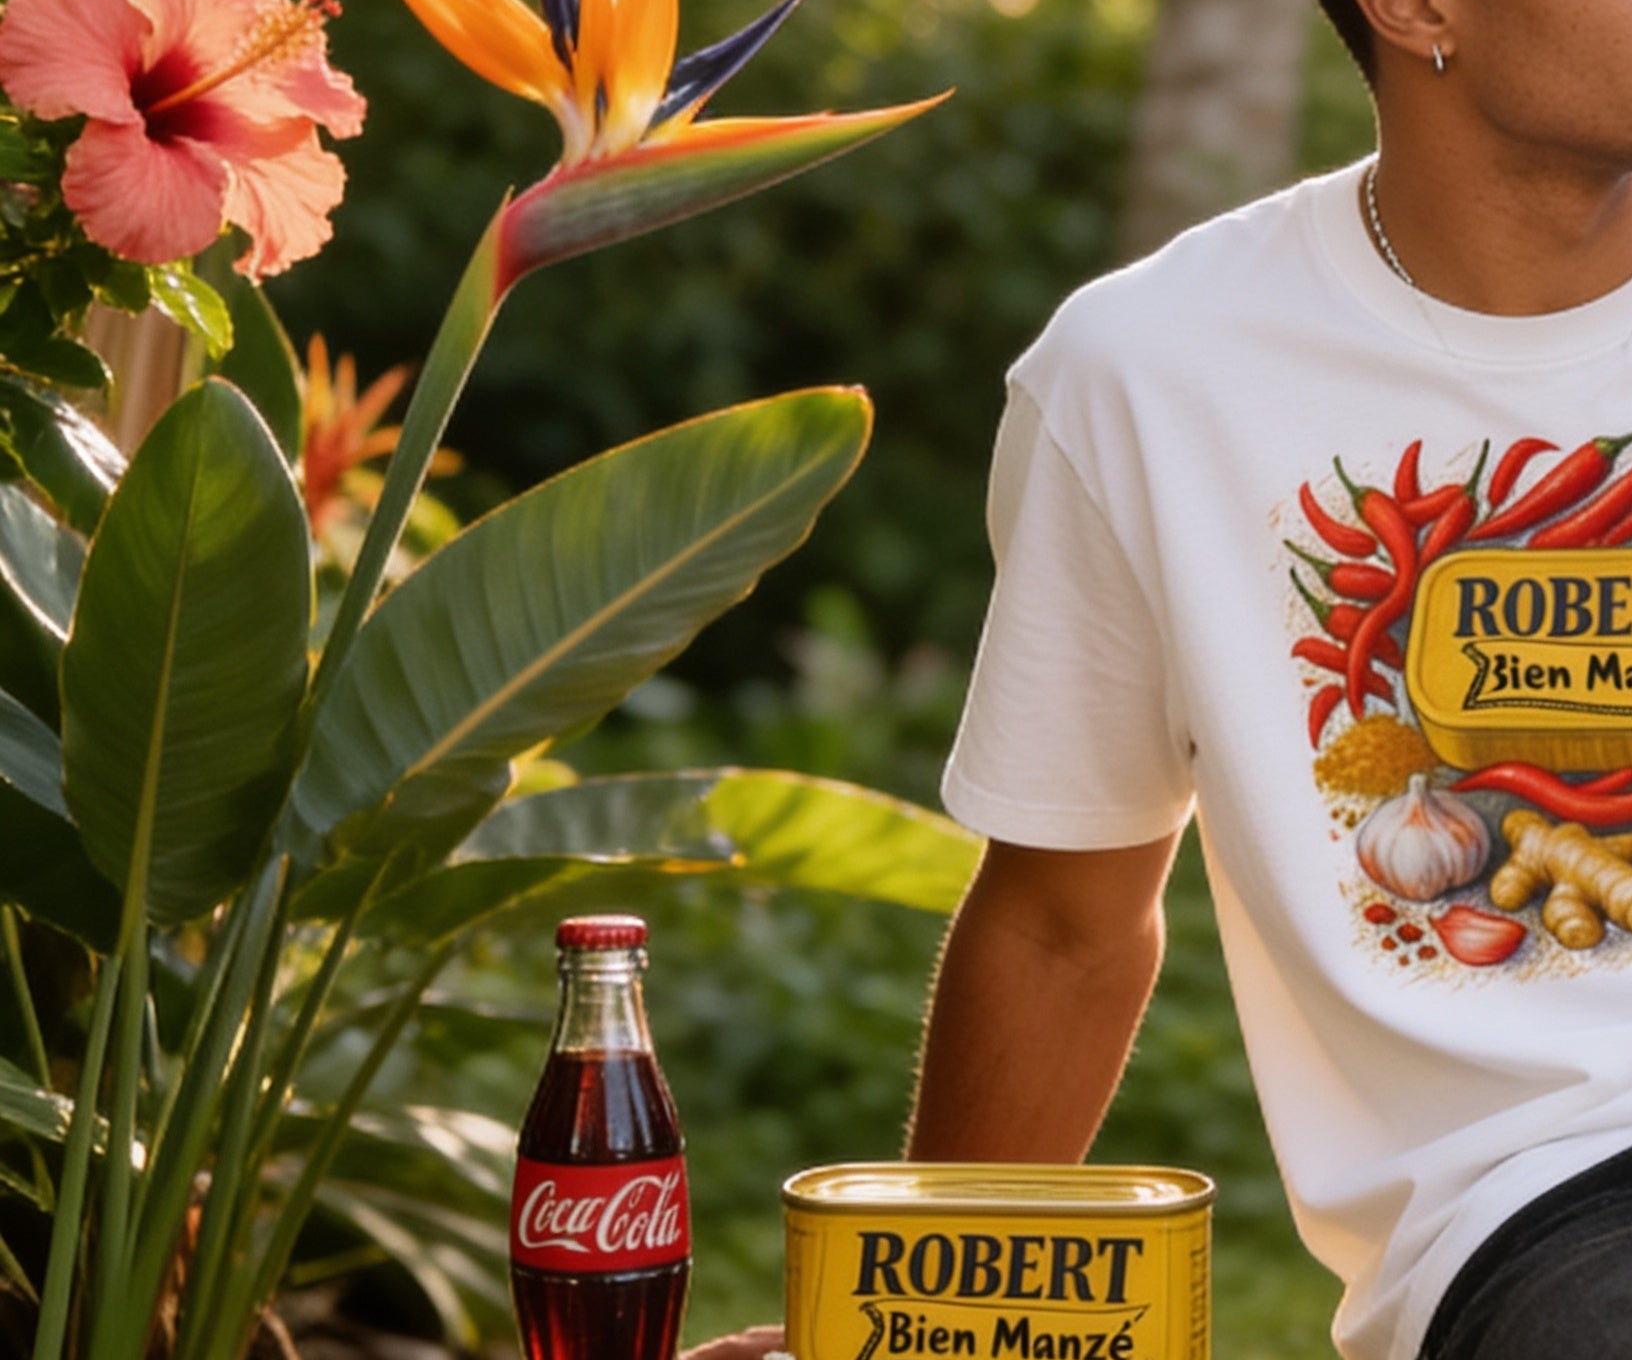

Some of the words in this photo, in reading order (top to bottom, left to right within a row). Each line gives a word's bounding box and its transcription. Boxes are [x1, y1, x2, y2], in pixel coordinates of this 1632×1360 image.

[1490, 652, 1572, 692] Bien
[518, 1179, 606, 1253] Coca
[595, 1170, 682, 1253] Cola
[852, 1230, 1144, 1304] ROBERT
[888, 1311, 976, 1356] Bien
